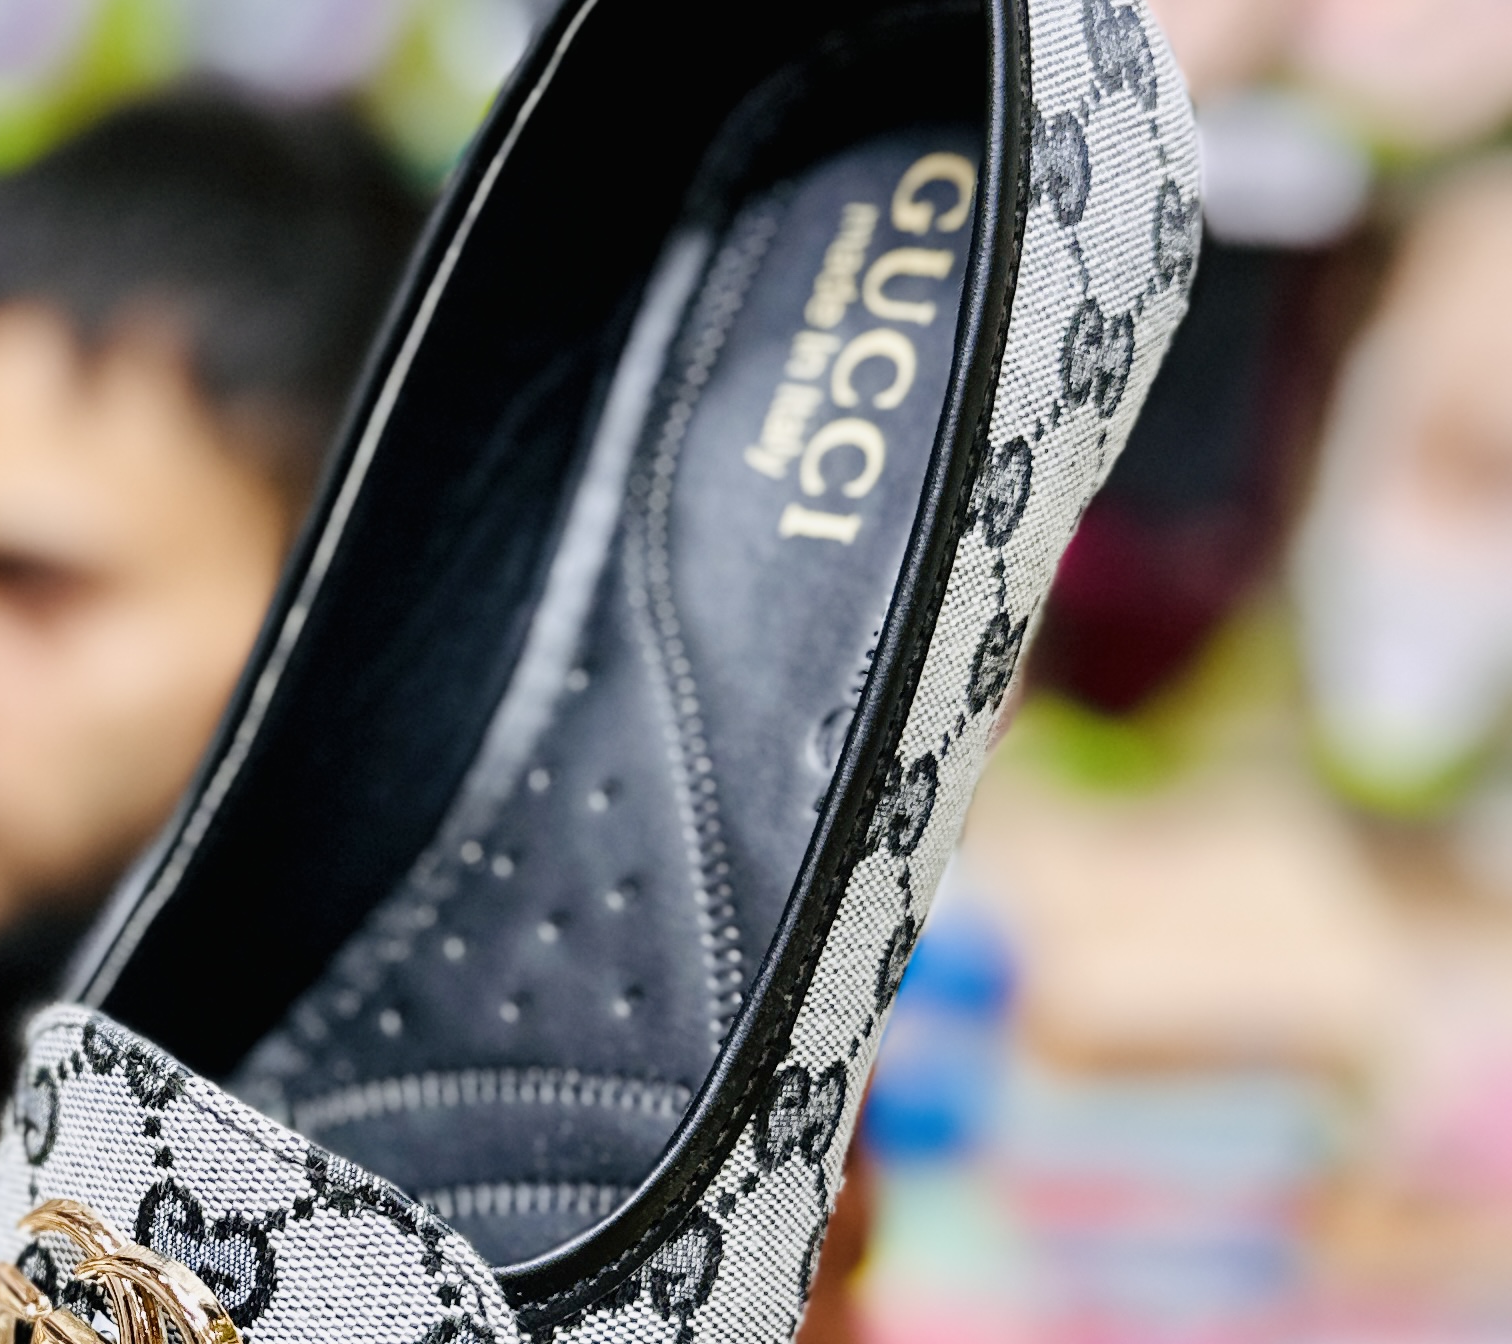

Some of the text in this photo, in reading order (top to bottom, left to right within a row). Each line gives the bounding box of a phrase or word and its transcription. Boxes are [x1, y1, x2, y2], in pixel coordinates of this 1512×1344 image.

[805, 203, 879, 329] made
[778, 152, 976, 545] GUCCI
[785, 330, 840, 381] in
